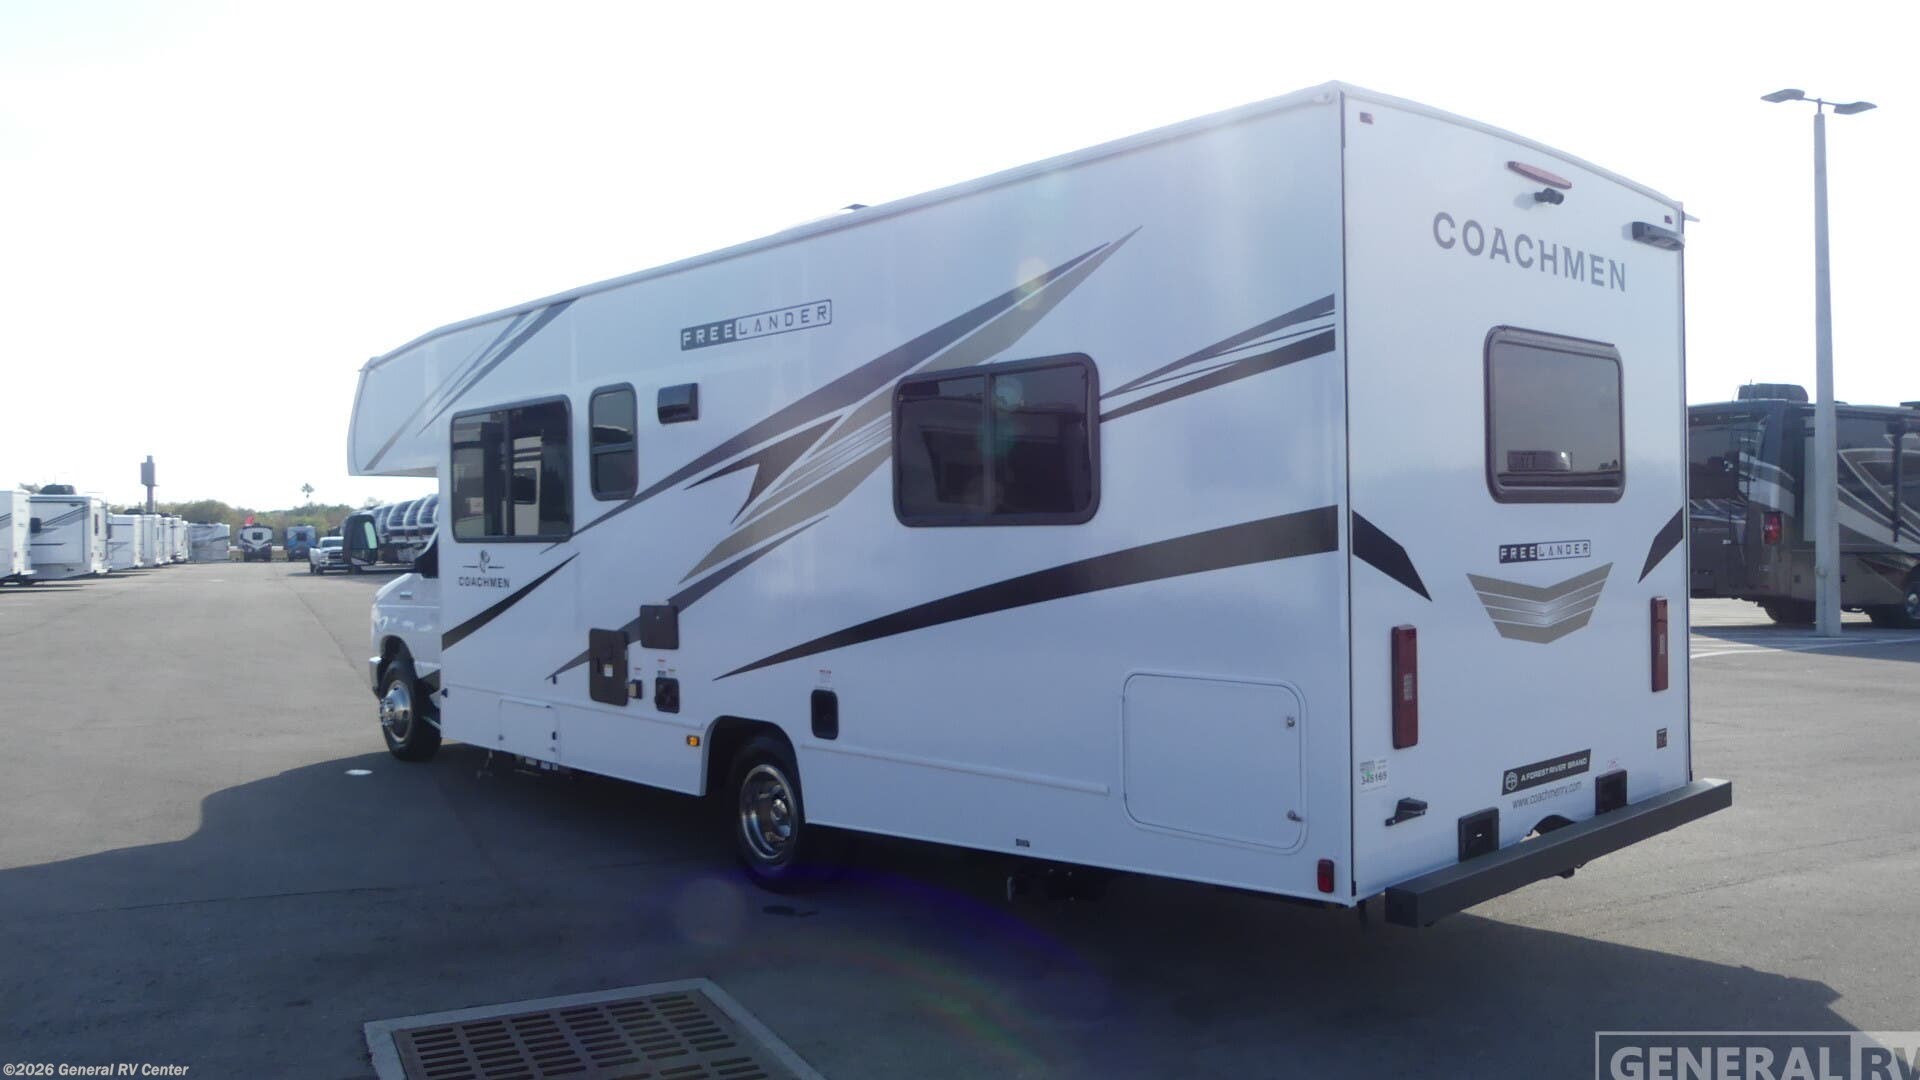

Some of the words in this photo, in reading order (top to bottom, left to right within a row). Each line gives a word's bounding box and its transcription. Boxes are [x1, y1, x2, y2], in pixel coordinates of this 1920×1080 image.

[1432, 211, 1626, 292] COACHMEN
[458, 576, 511, 588] COACHMEN
[1526, 768, 1549, 780] FOREST
[1549, 763, 1567, 777] RIVER
[1567, 757, 1588, 770] BRAND
